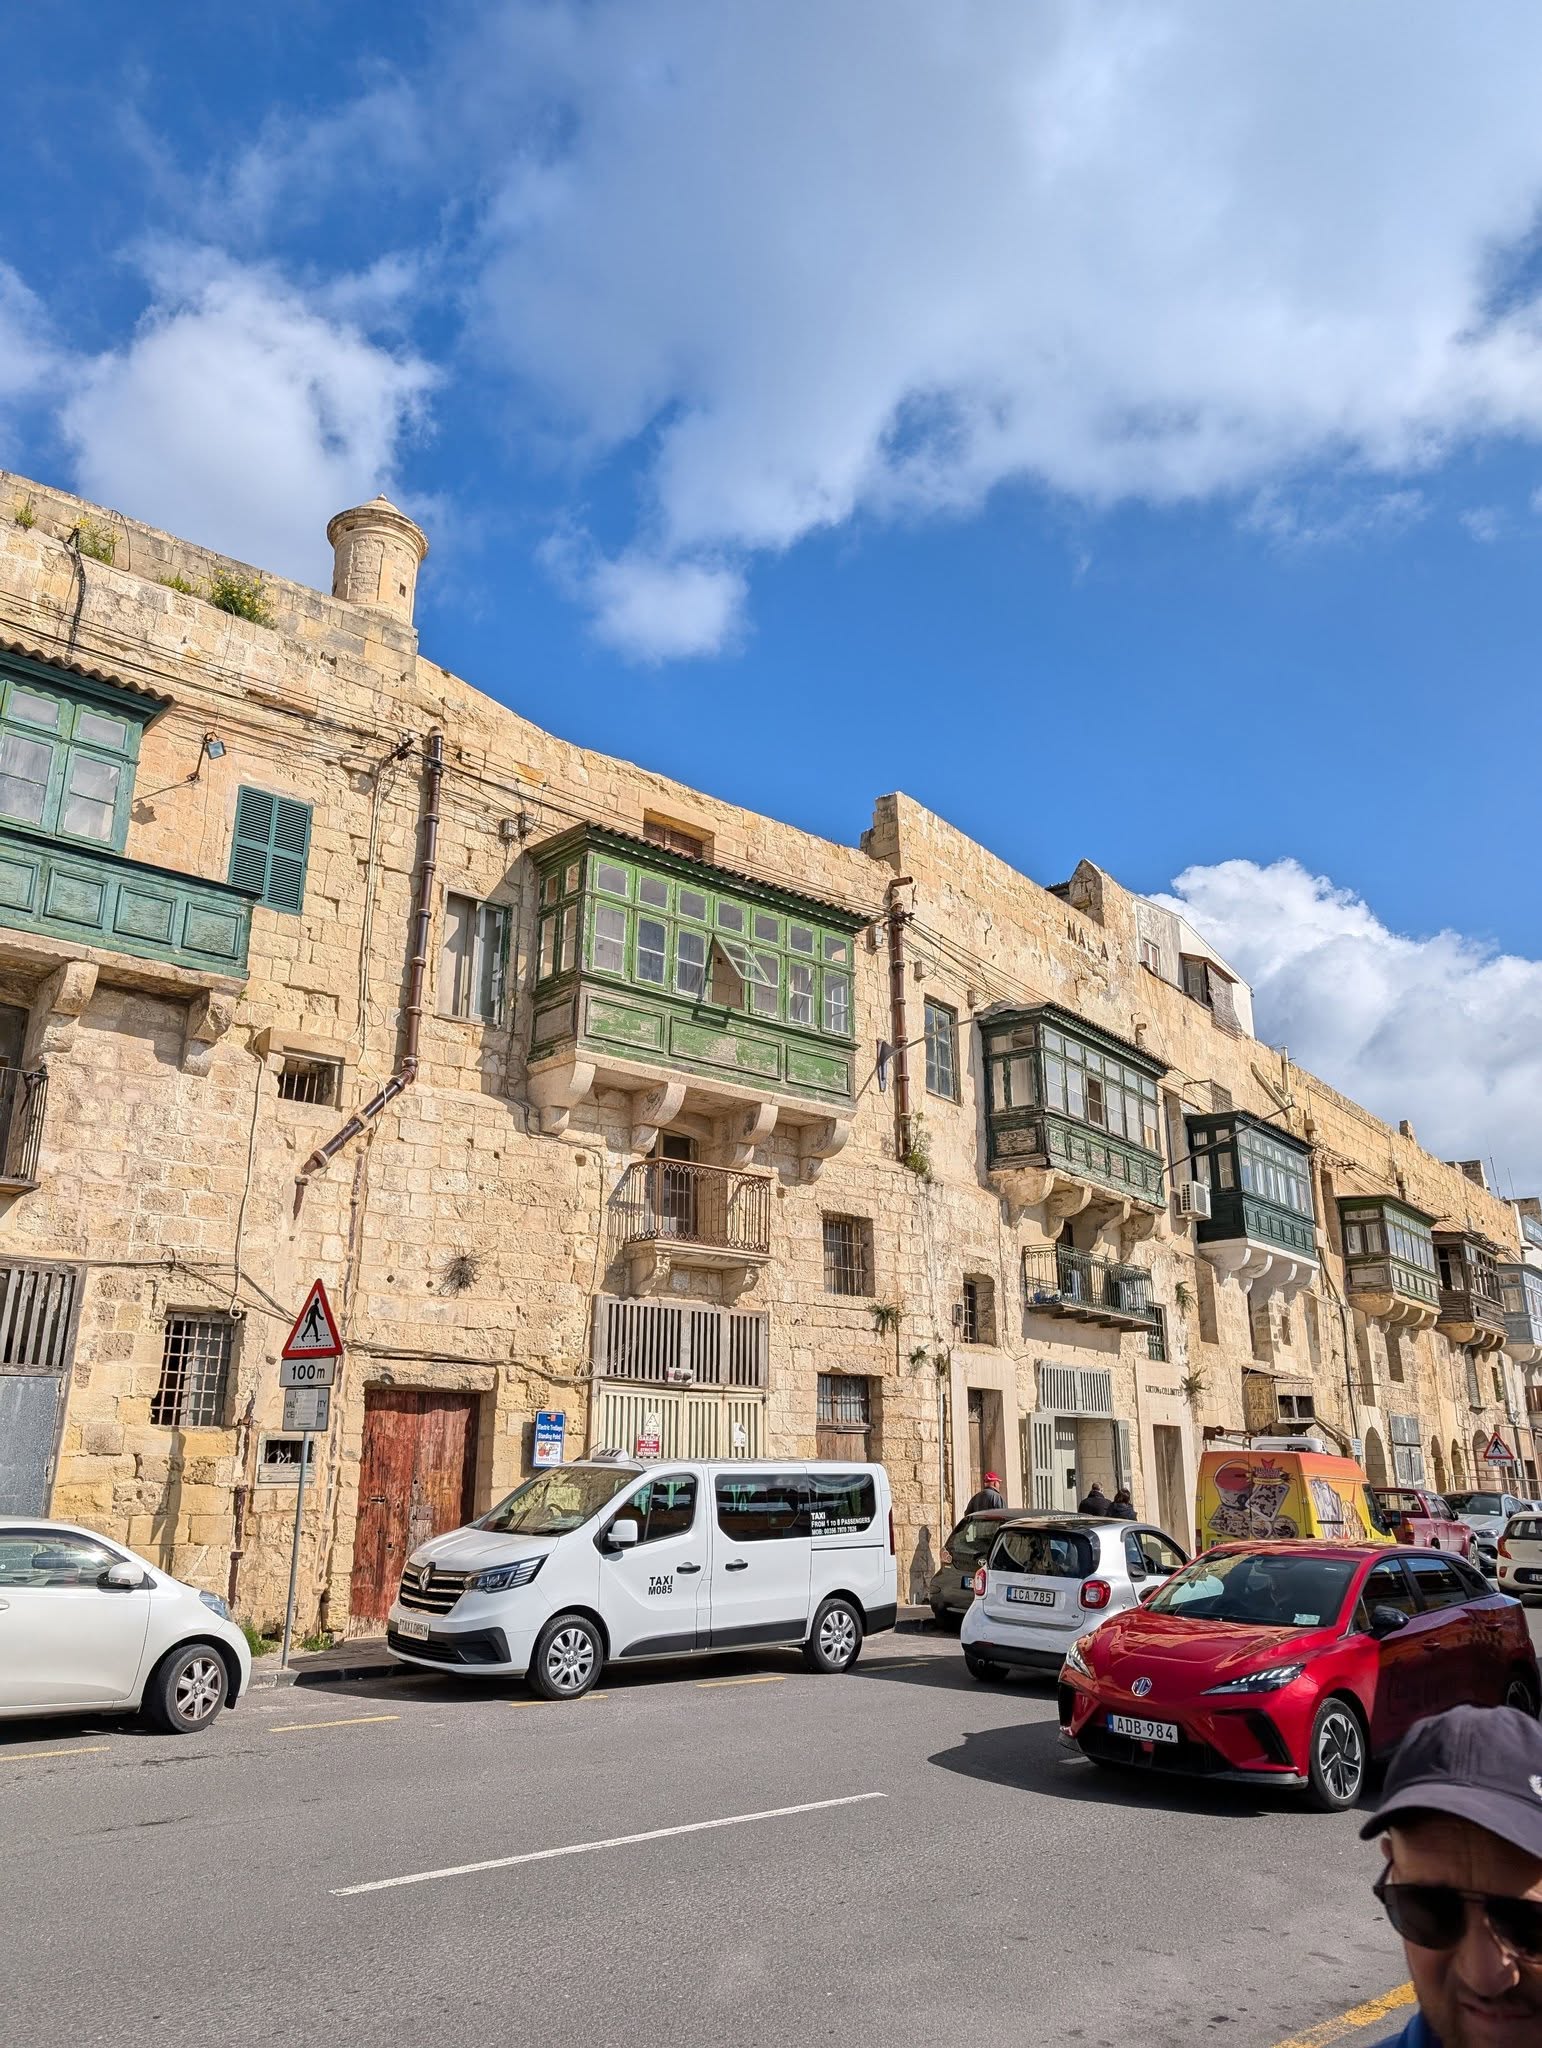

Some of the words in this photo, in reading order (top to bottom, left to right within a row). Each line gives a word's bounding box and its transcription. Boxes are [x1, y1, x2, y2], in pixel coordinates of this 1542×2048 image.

[292, 1365, 325, 1380] 100m
[811, 1512, 826, 1520] TAXI
[649, 1575, 673, 1586] TAXI
[648, 1585, 672, 1595] M085
[1013, 1590, 1030, 1600] ICA
[1033, 1592, 1051, 1603] 785
[1117, 1718, 1141, 1735] ADB
[1147, 1723, 1173, 1740] 984
